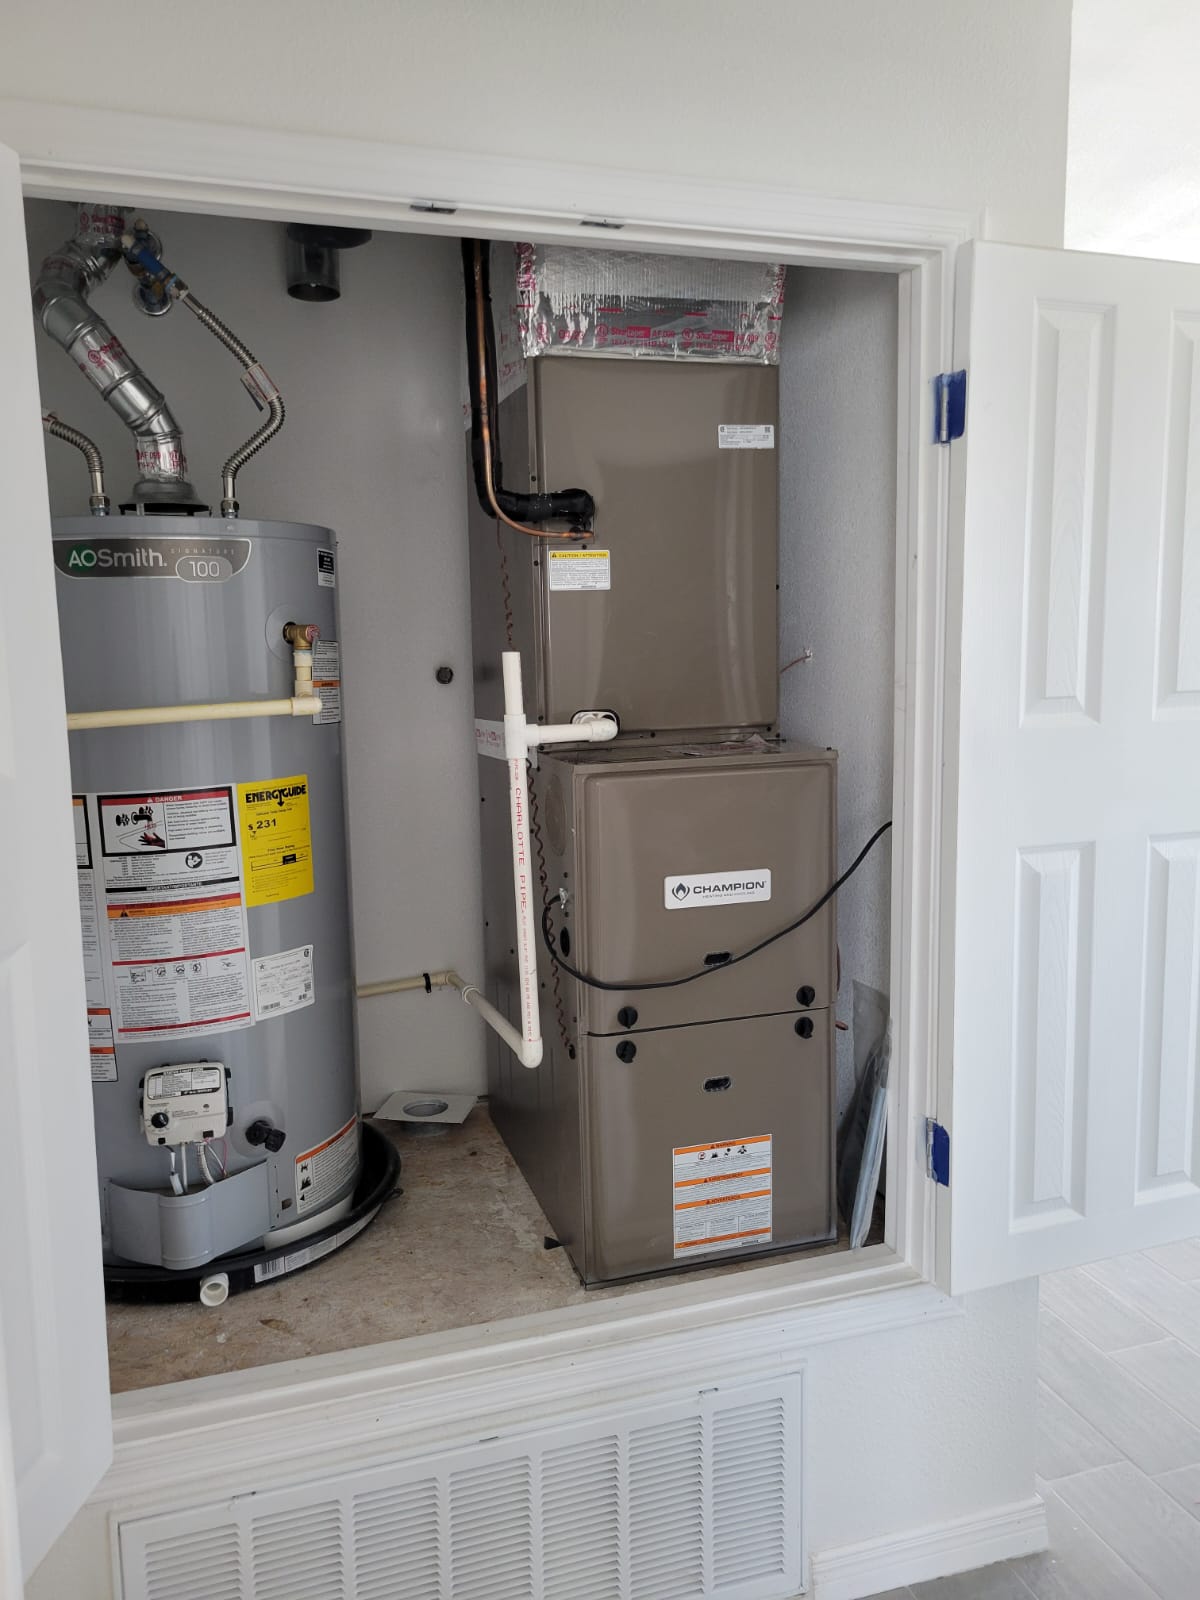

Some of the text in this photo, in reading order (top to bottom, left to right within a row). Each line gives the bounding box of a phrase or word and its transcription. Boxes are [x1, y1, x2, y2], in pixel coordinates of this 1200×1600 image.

[188, 561, 220, 577] 100
[256, 818, 277, 830] 231
[515, 788, 525, 865] CHARLOTTE
[693, 881, 764, 894] CHAMPION
